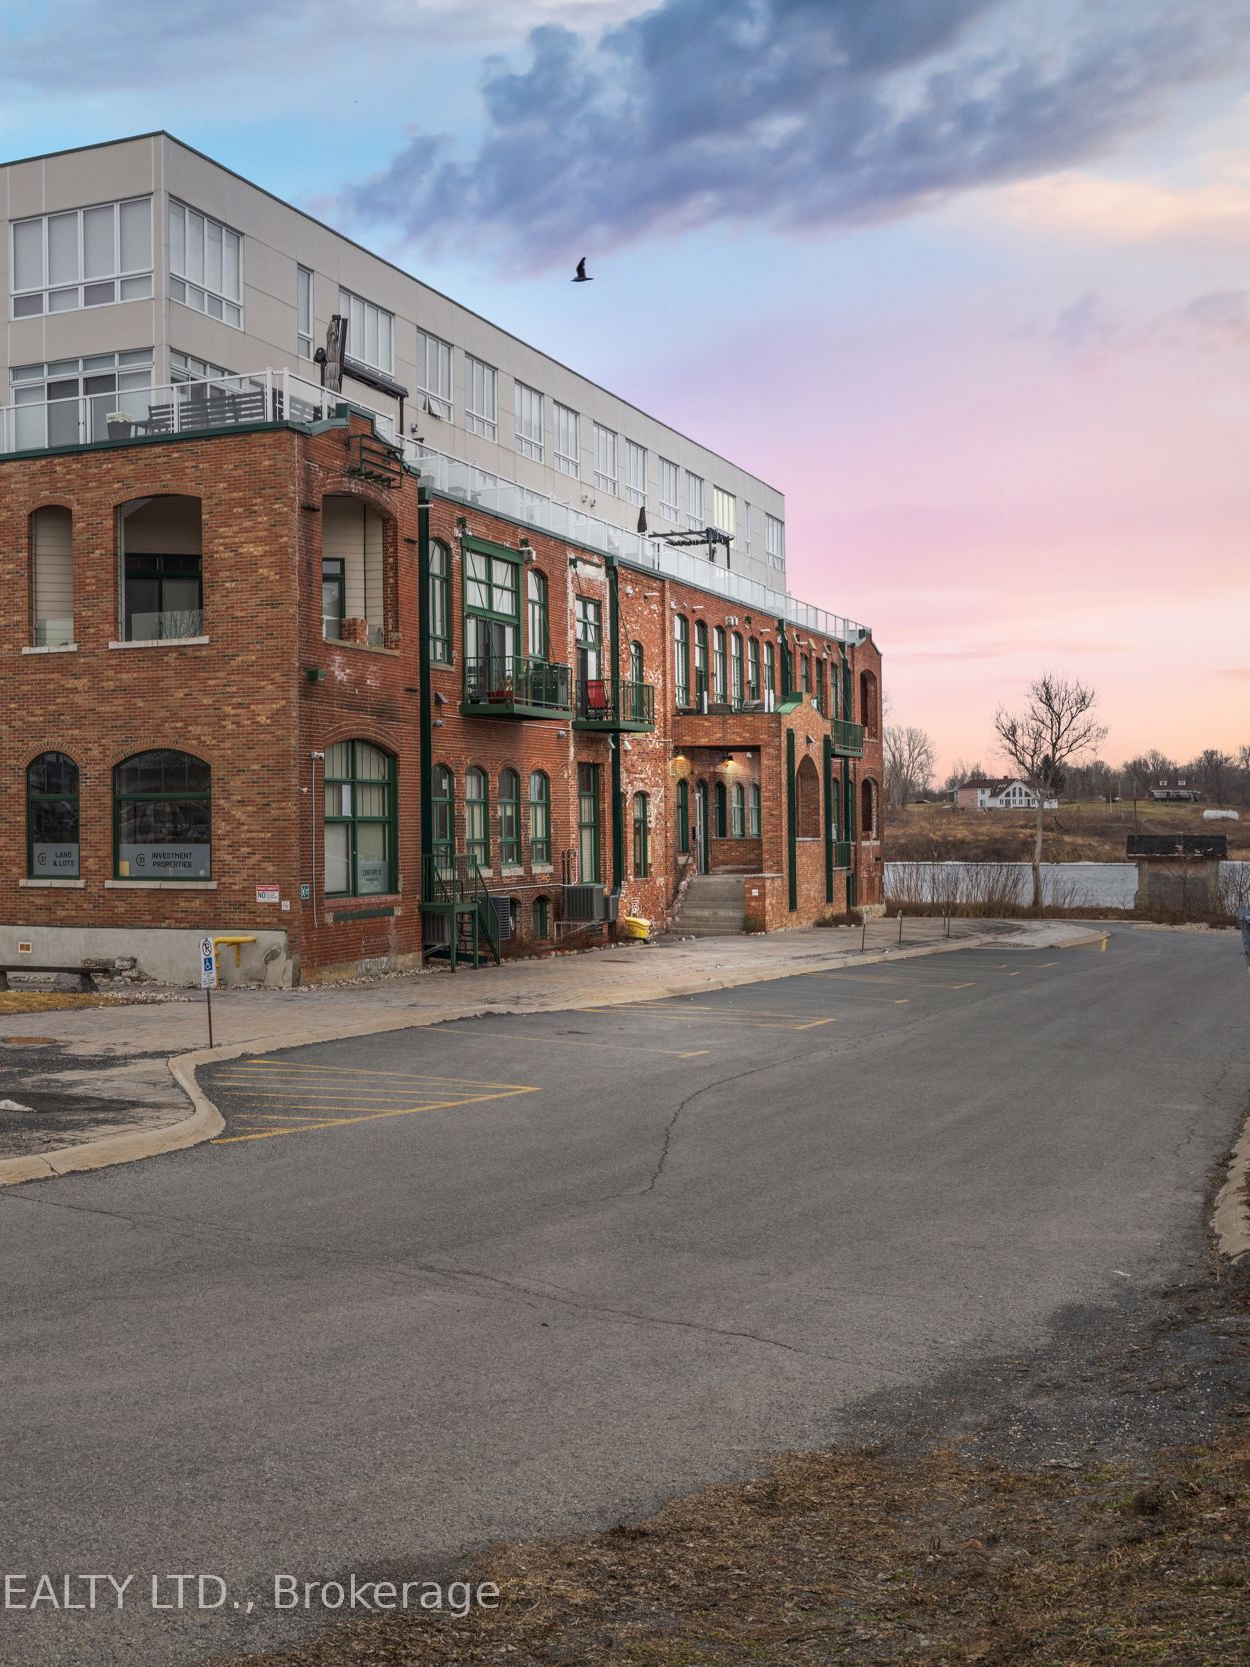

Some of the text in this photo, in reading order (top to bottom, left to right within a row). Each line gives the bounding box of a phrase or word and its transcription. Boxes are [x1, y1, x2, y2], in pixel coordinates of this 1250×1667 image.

[55, 851, 72, 859] LAND
[152, 852, 193, 860] INVESTMENT
[53, 859, 75, 867] & LOTS
[152, 861, 192, 869] PROPERTIES
[257, 891, 266, 899] NO
